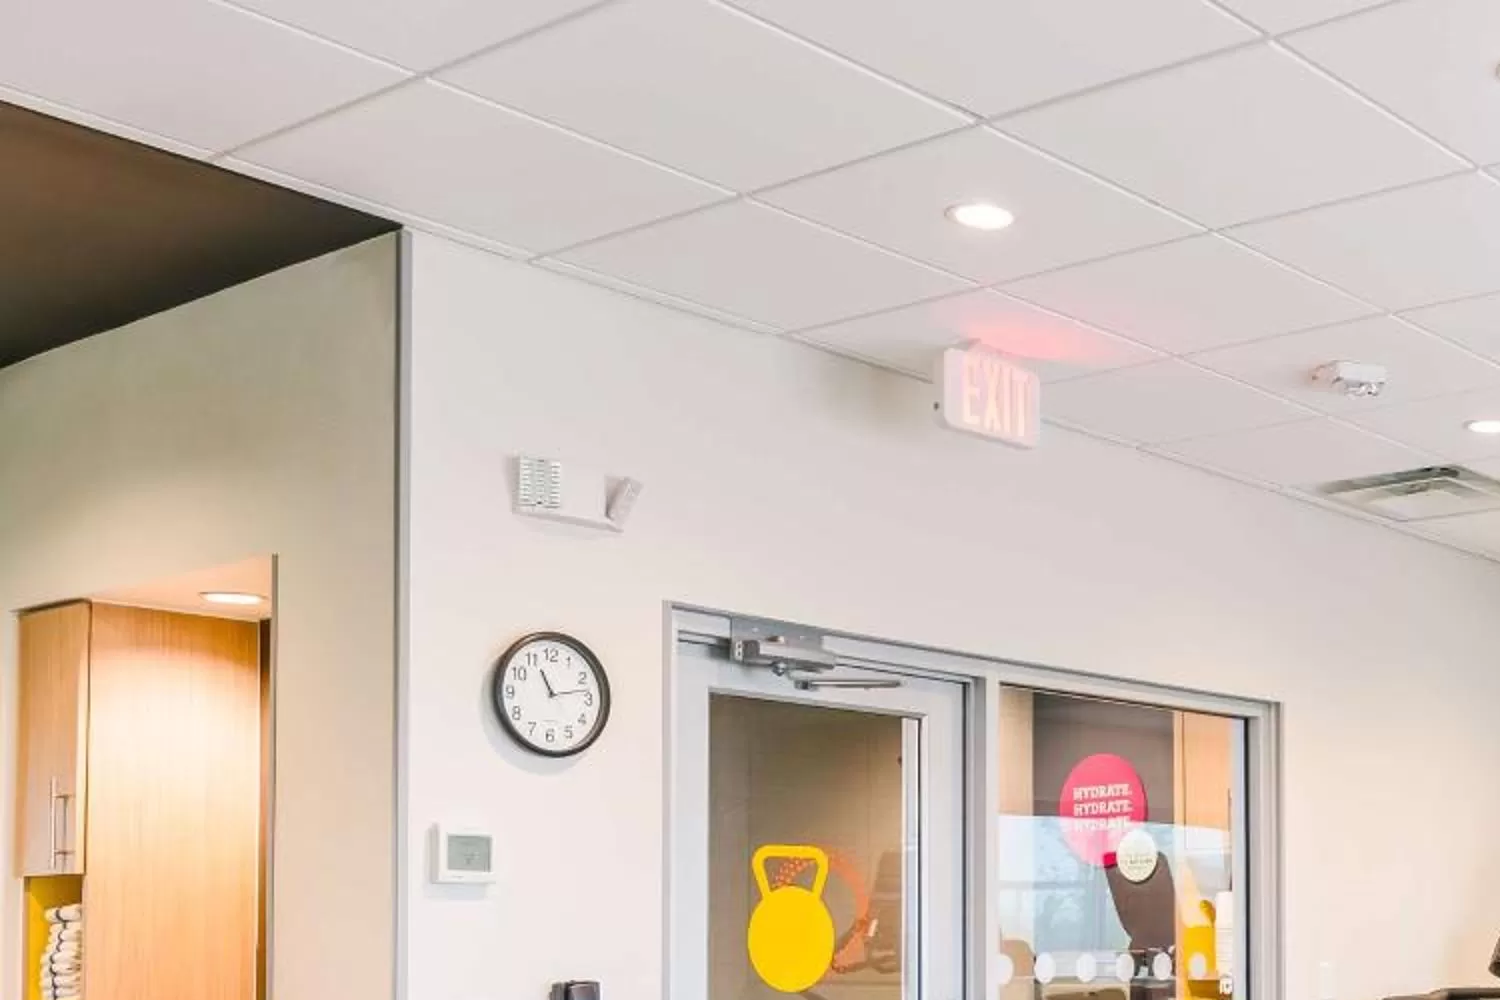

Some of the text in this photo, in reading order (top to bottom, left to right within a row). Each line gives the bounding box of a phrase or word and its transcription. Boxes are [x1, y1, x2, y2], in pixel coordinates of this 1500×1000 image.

[963, 354, 1030, 437] EXIT
[526, 652, 538, 667] 11
[544, 648, 559, 663] 12
[566, 656, 571, 669] 1
[512, 666, 527, 681] 10
[578, 671, 588, 685] 2
[505, 684, 515, 699] 9
[584, 691, 594, 707] 3
[512, 705, 521, 721] 8
[578, 713, 587, 725] 4
[528, 721, 537, 736] 7
[545, 728, 555, 743] 6
[564, 725, 573, 739] 5
